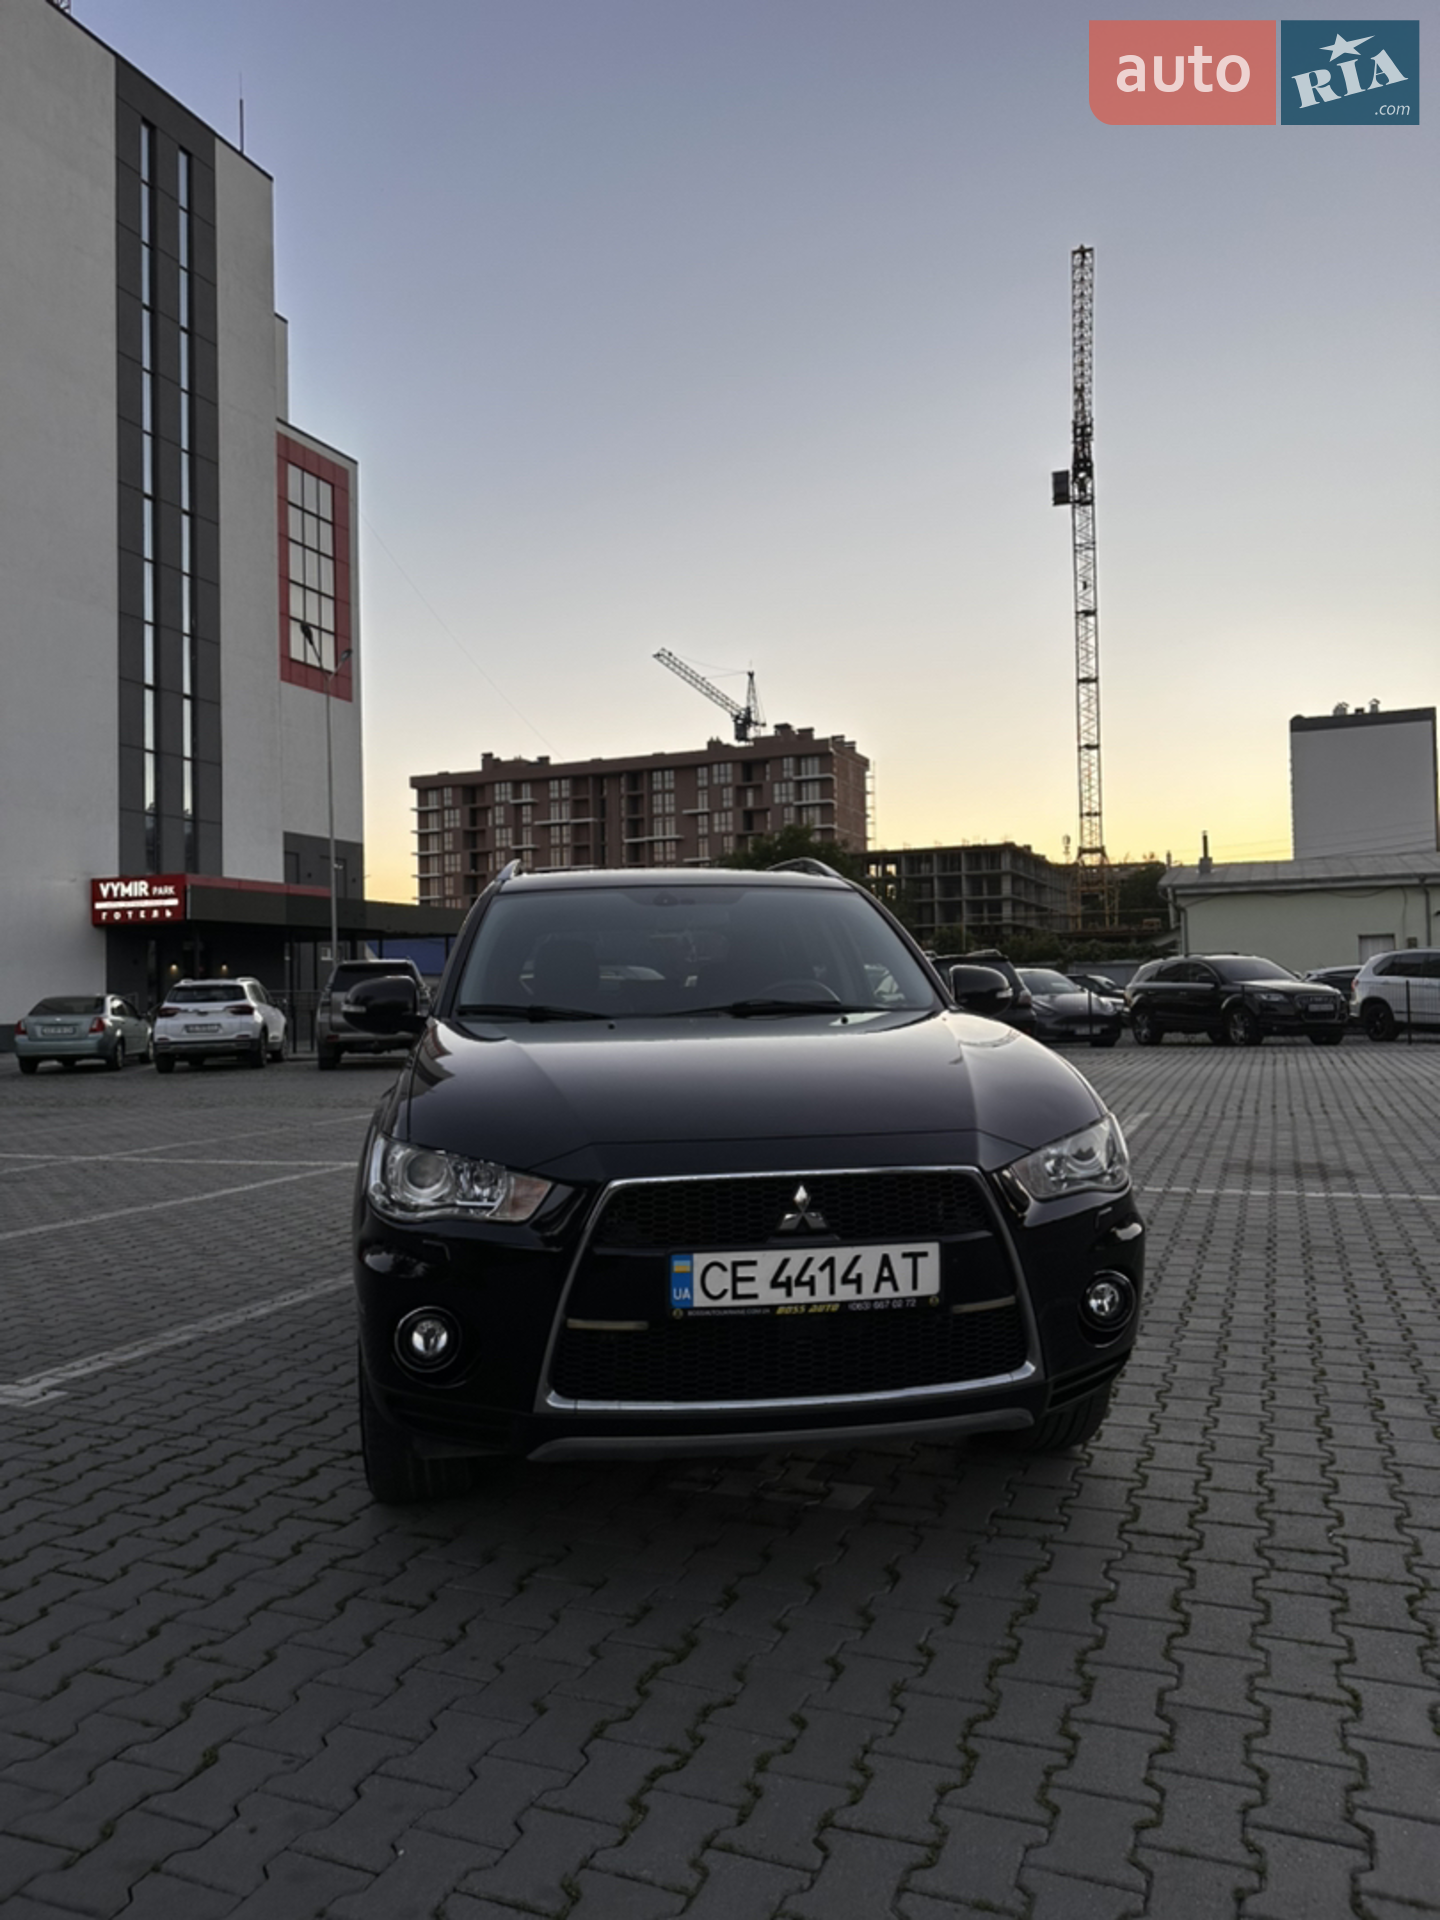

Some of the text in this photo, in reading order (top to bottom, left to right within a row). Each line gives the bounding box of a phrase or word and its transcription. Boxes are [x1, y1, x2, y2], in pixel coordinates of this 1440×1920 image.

[99, 880, 175, 898] VYMIR PARK
[101, 908, 172, 921] ГОТЕЛЬ
[700, 1251, 929, 1301] CE 4414 AT
[673, 1287, 691, 1300] UA
[776, 1303, 841, 1315] BOSS AUTO
